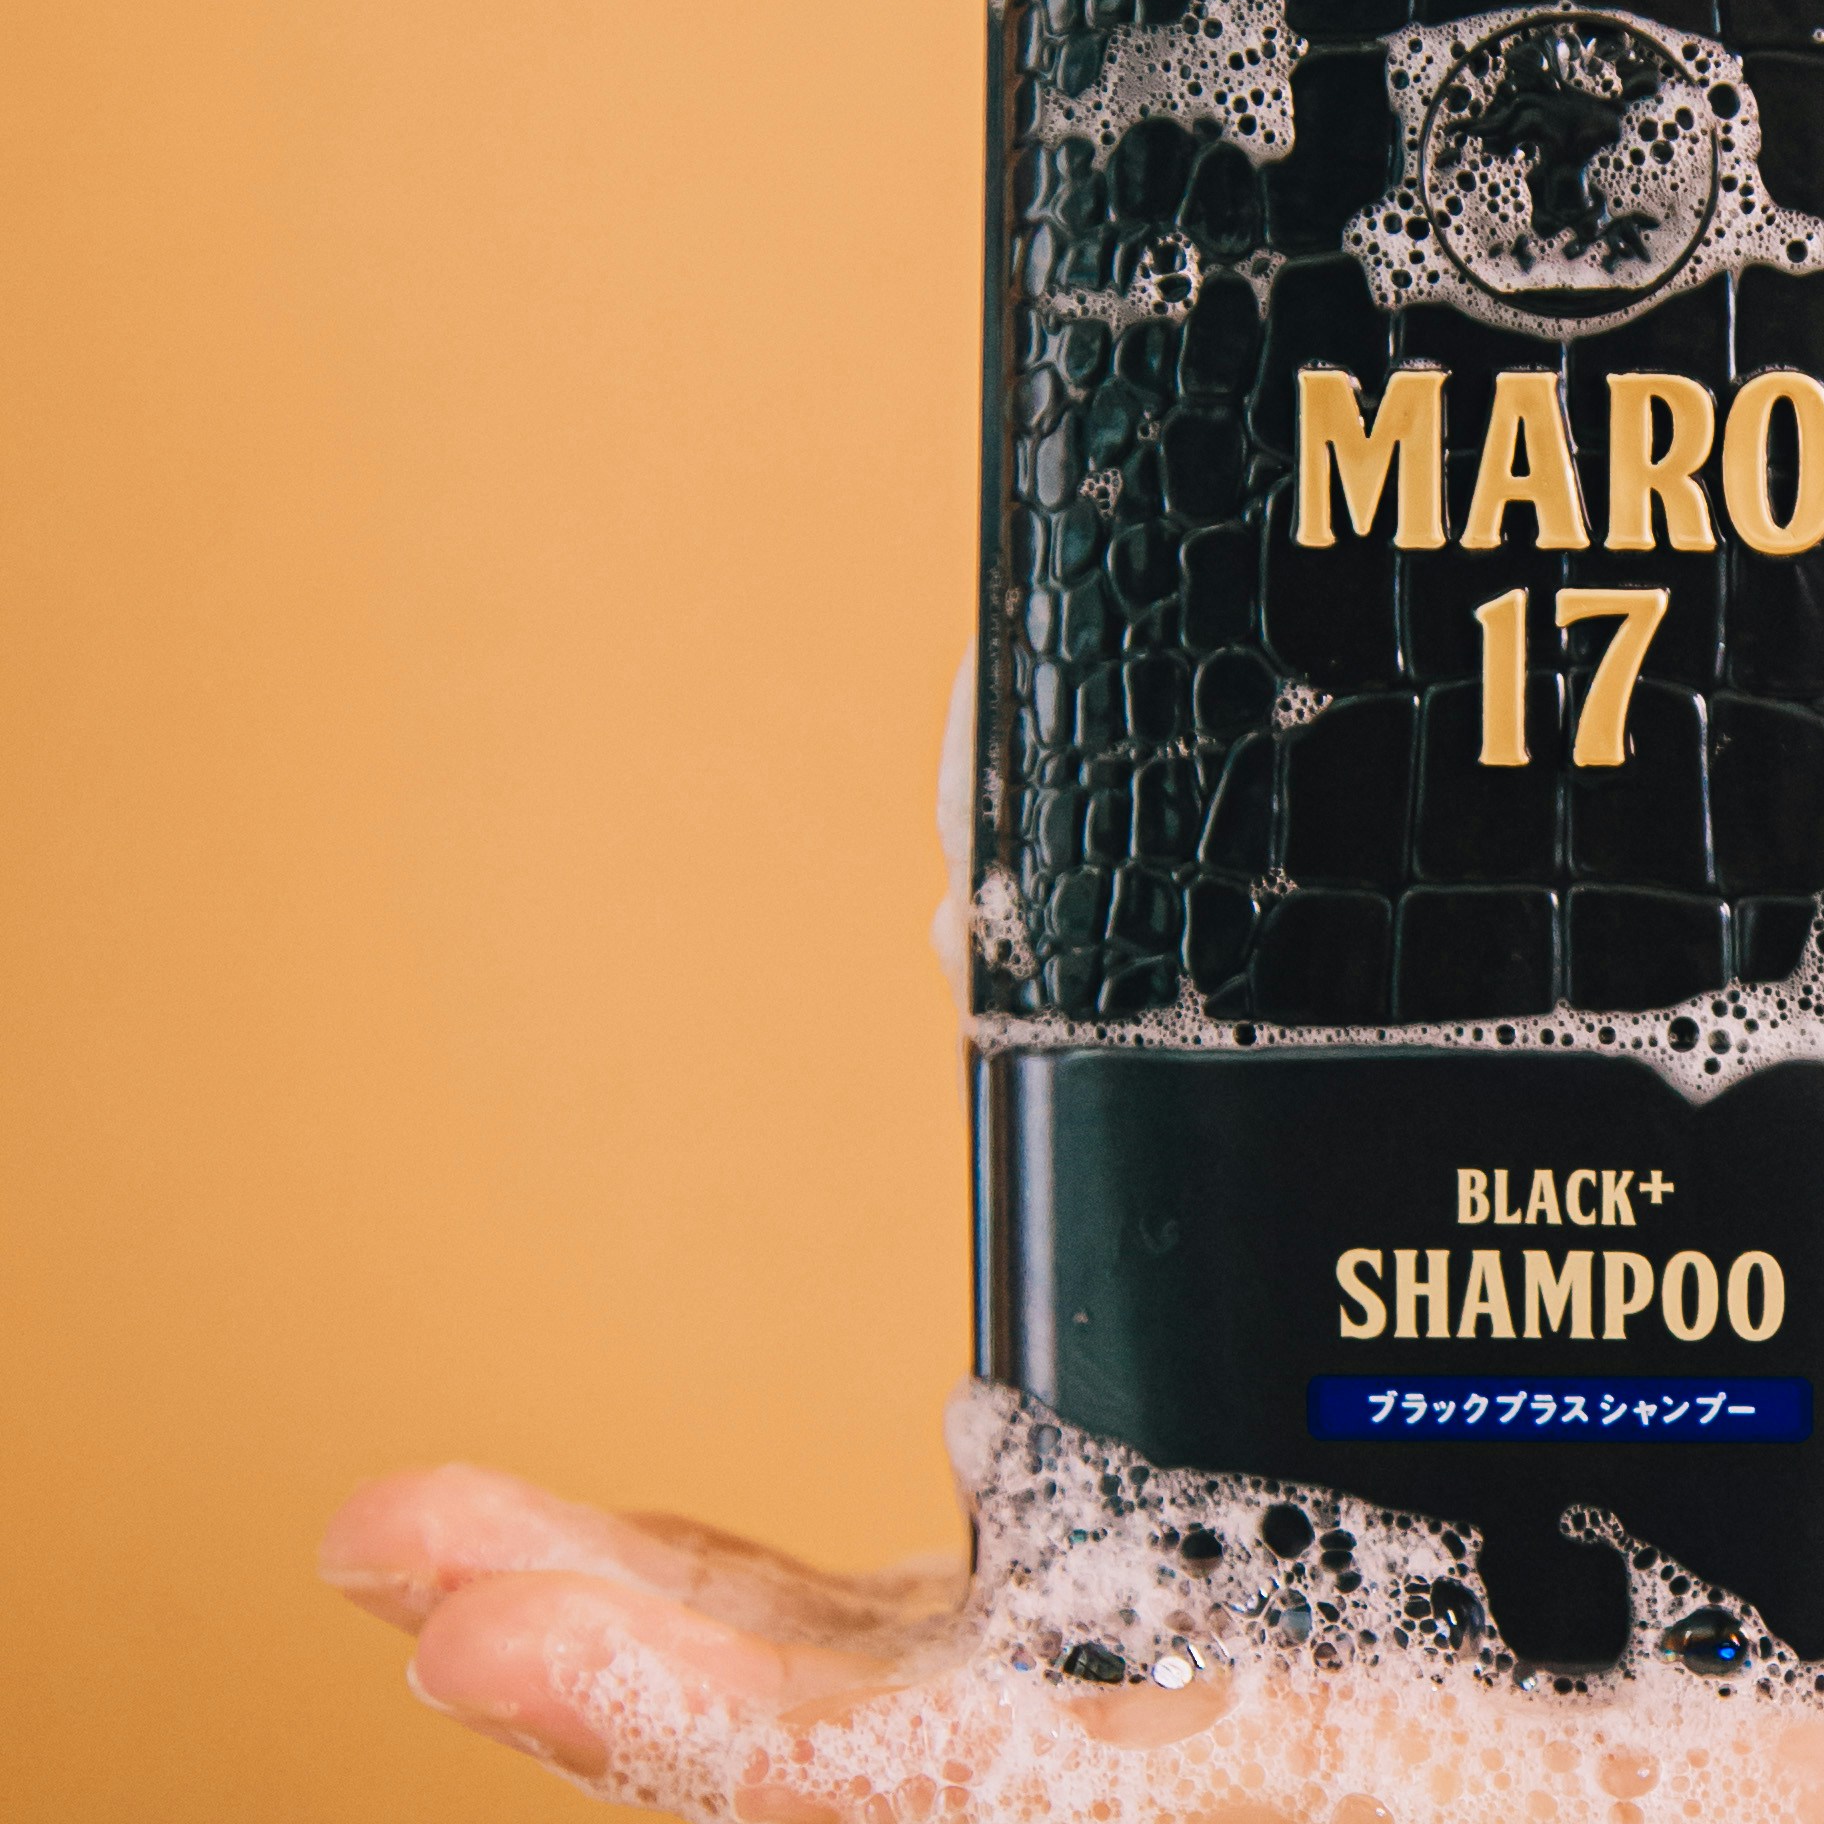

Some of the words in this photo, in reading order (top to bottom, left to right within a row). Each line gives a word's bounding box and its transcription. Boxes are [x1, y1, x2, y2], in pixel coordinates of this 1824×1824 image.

[1475, 586, 1671, 768] 17
[1456, 1167, 1676, 1226] BLACK+
[1334, 1247, 1787, 1343] SHAMPOO
[1367, 1389, 1757, 1426] ブラックプラスシャンプー
